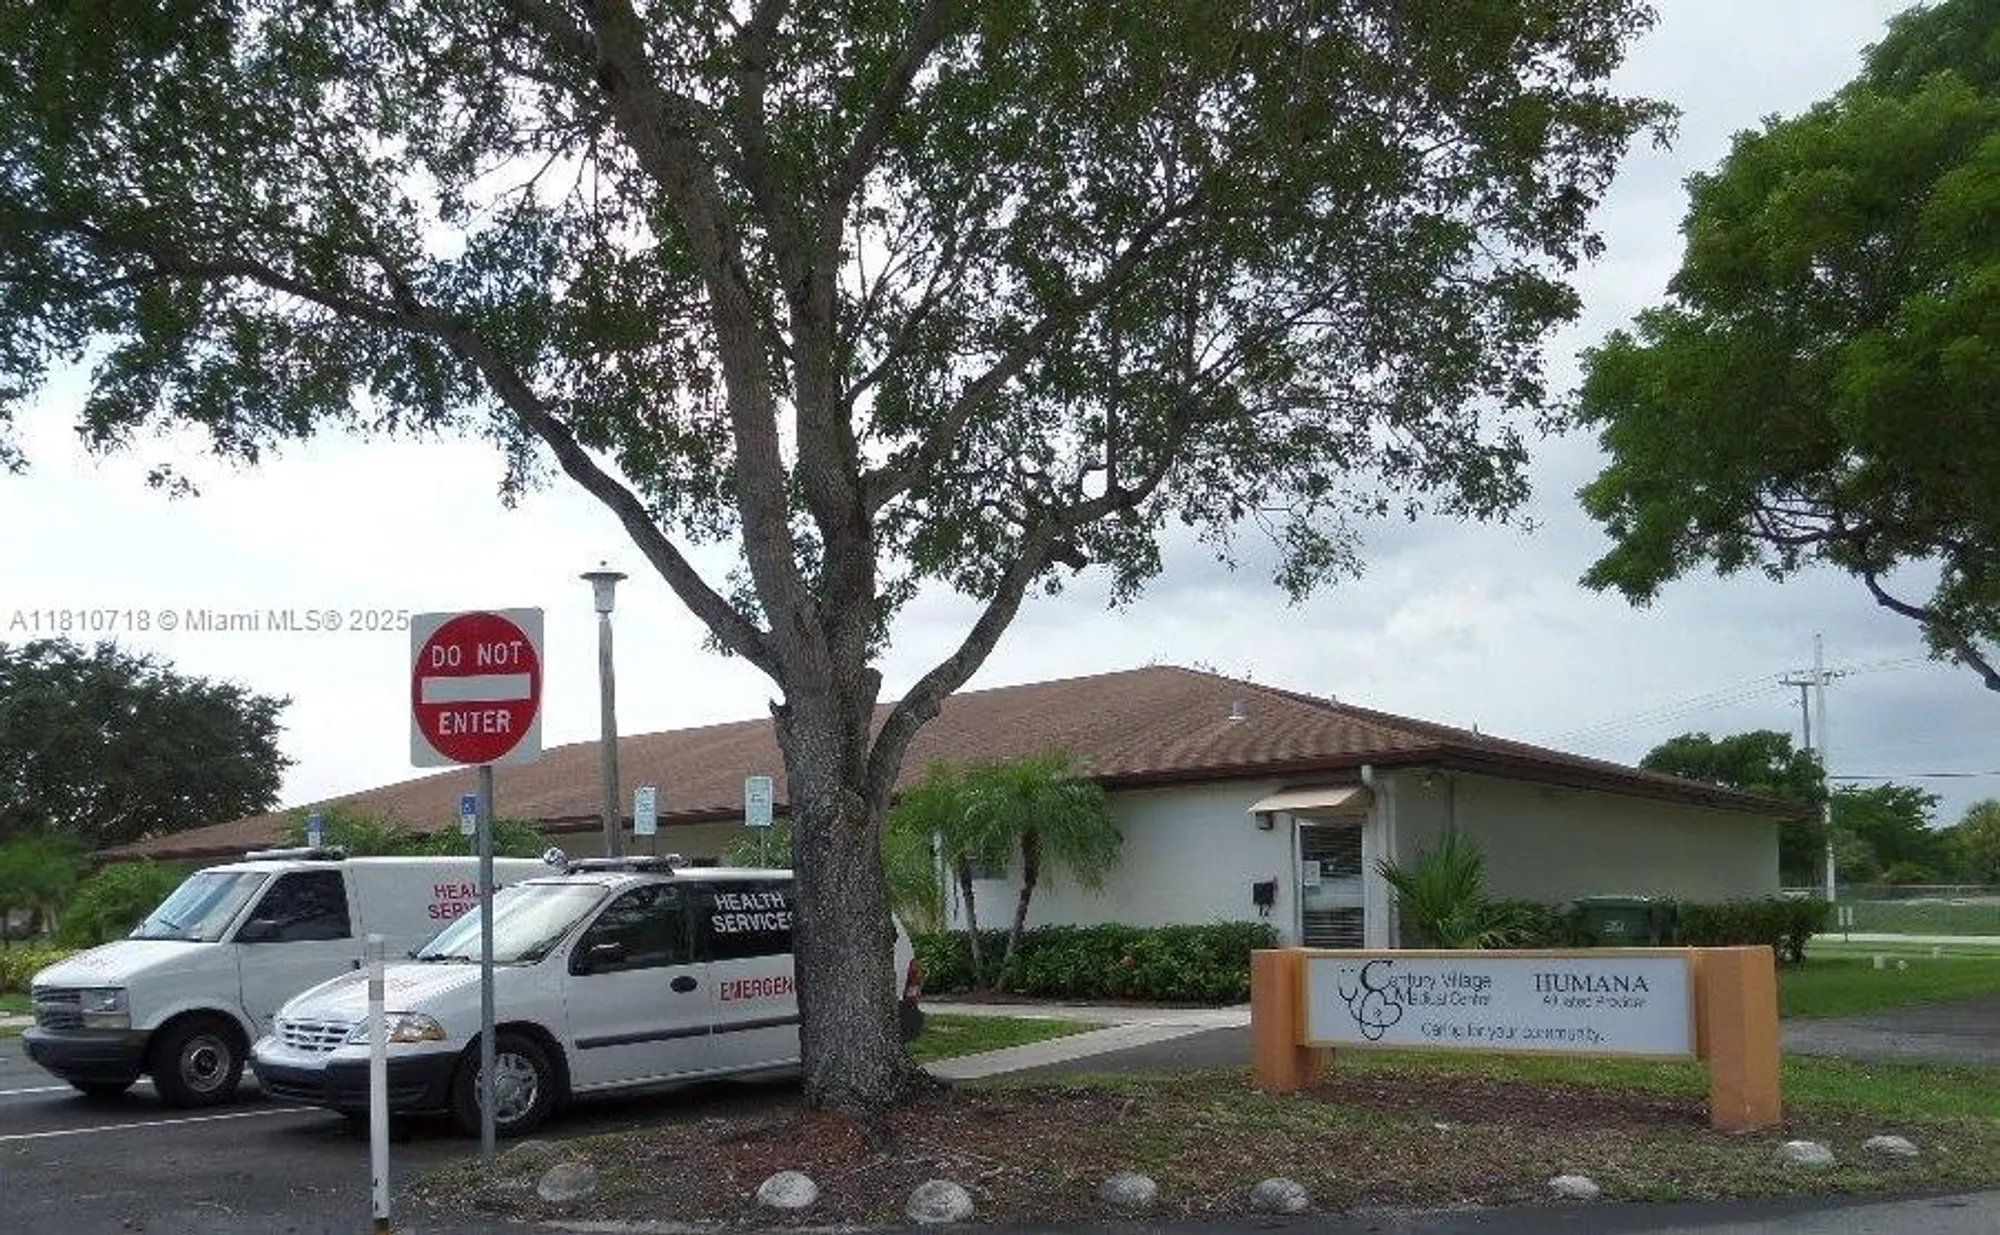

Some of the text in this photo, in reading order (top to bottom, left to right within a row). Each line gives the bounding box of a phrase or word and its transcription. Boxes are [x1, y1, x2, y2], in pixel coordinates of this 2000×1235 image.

[431, 641, 522, 667] DO NOT
[438, 710, 511, 735] ENTER
[434, 884, 502, 899] HEALH
[428, 903, 477, 919] SERV
[714, 893, 786, 910] HEALTH
[720, 976, 794, 1001] EMERGEN
[1441, 972, 1492, 992] Village
[1534, 973, 1649, 993] HUMANA
[1394, 988, 1447, 1006] Medical
[1467, 1023, 1484, 1037] for
[1487, 1026, 1518, 1041] your
